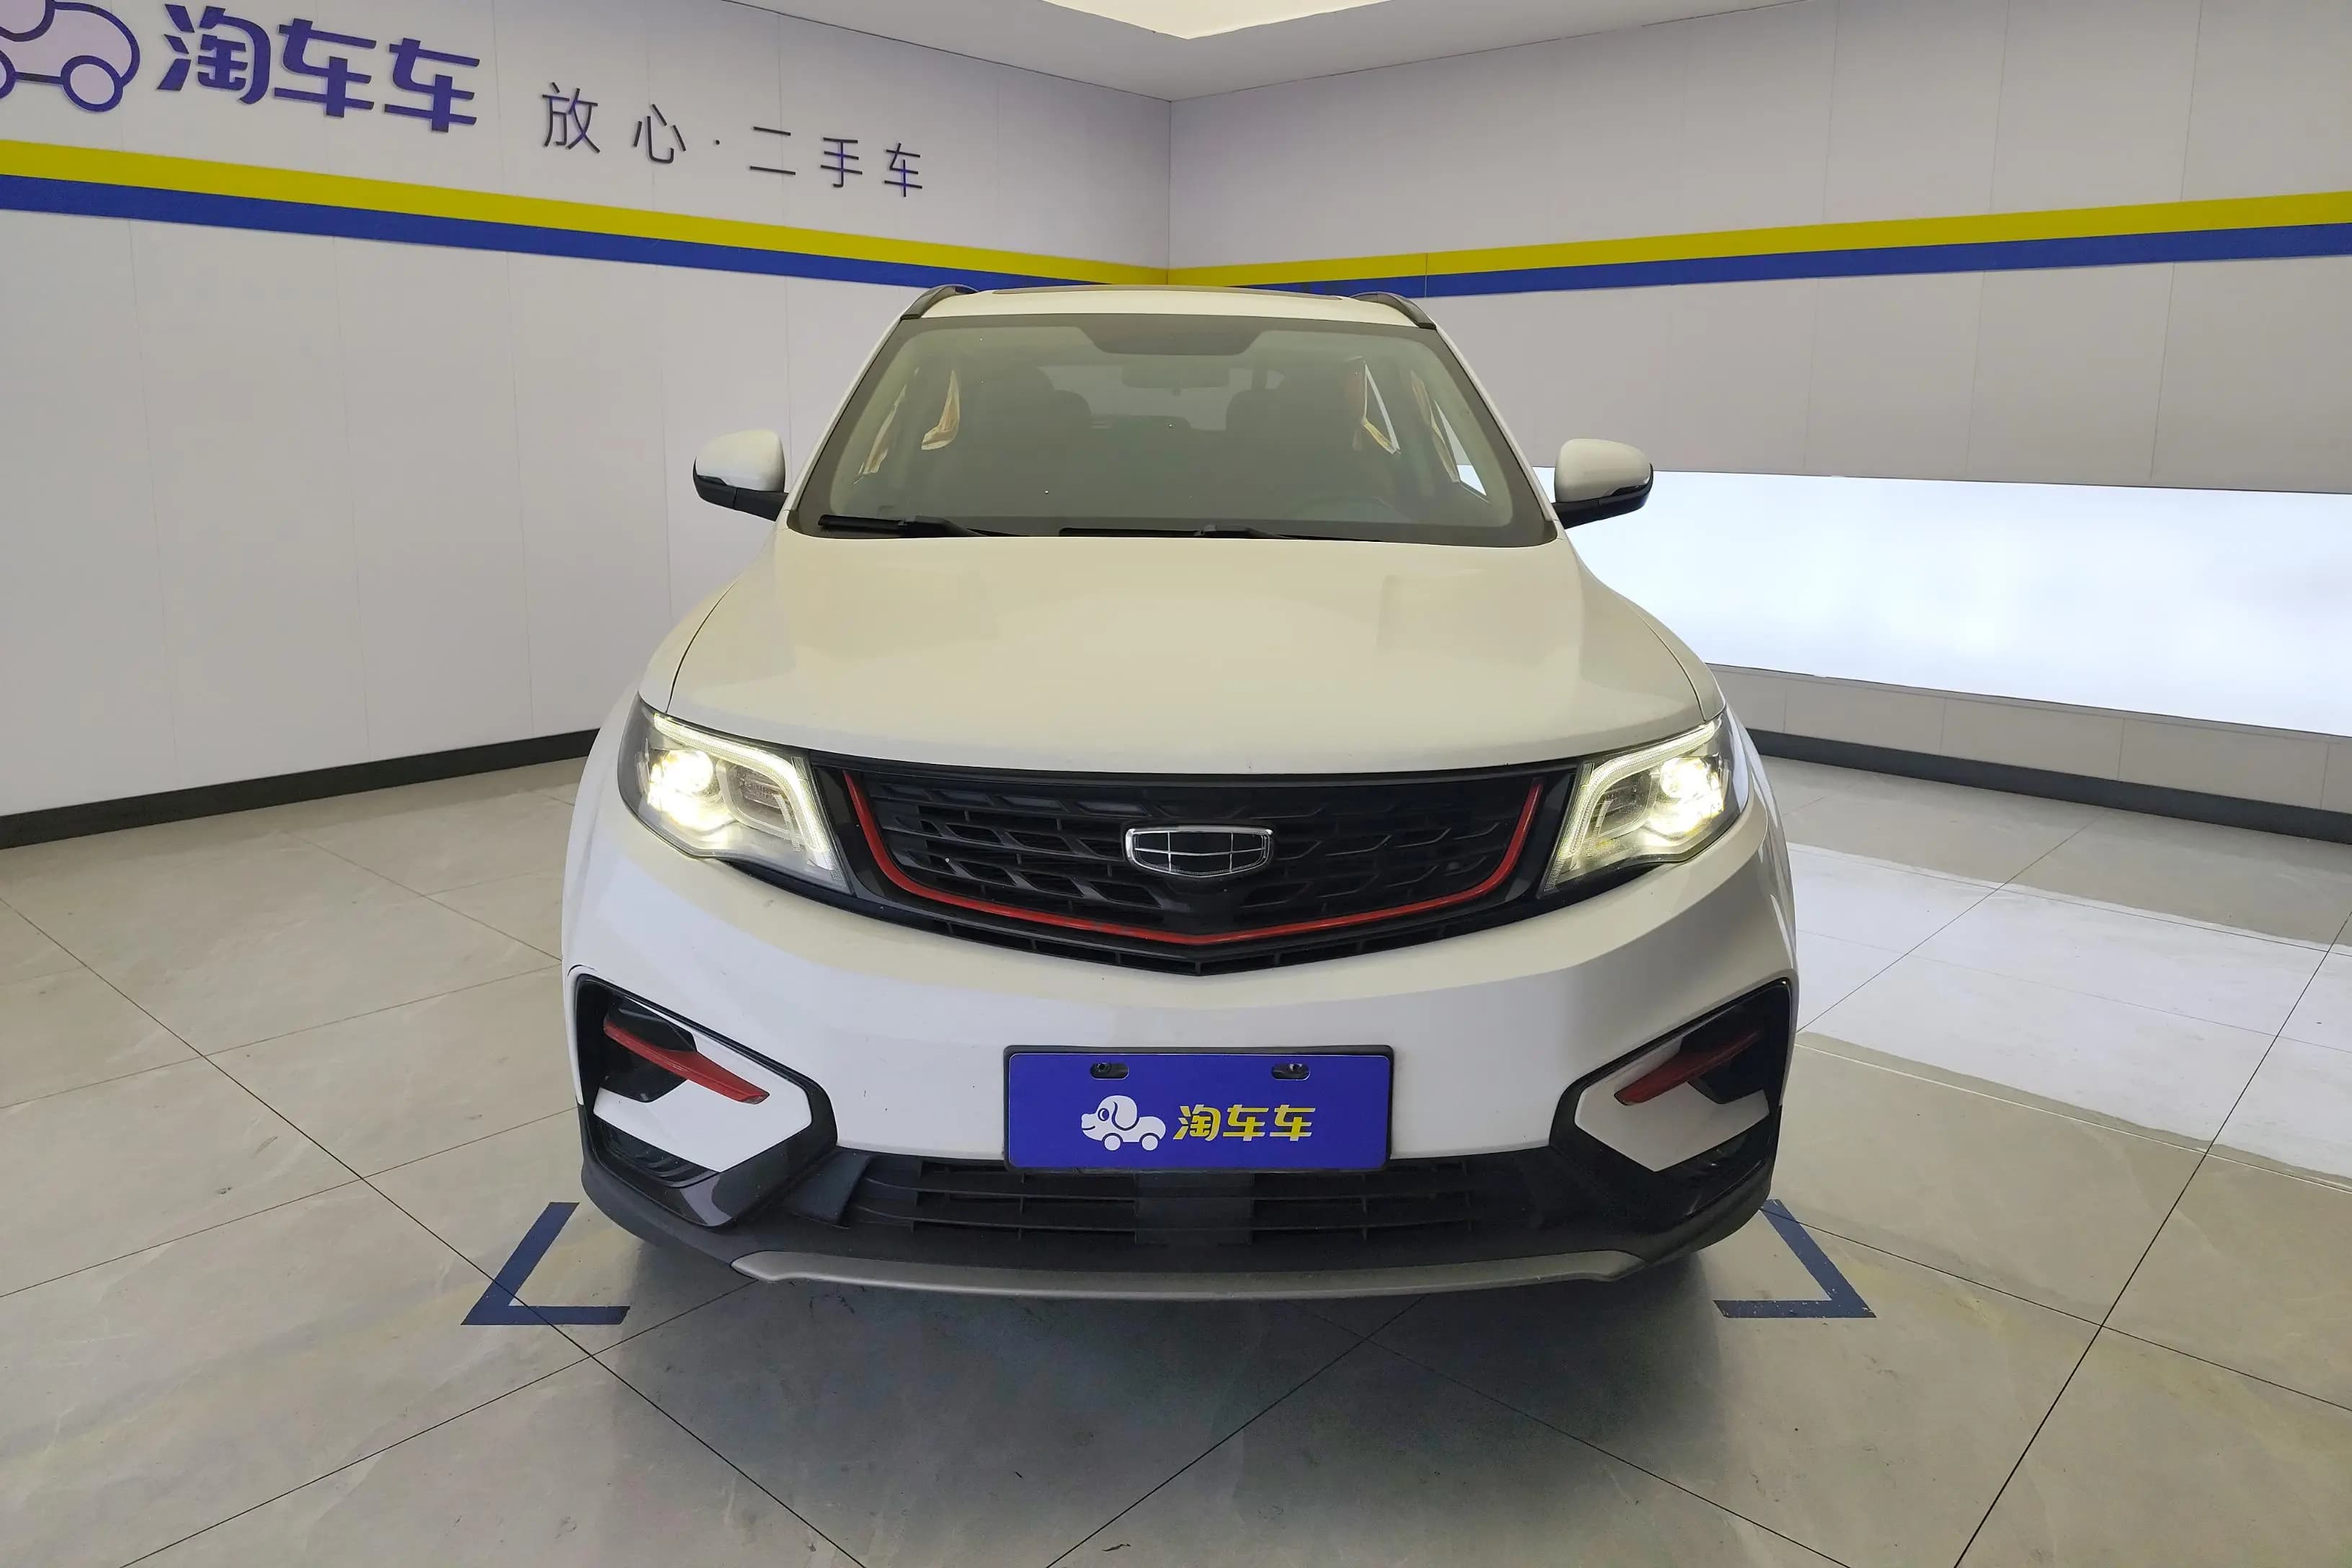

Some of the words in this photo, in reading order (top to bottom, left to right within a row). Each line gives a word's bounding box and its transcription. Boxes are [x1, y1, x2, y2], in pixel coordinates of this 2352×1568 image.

[157, 4, 481, 133] 淘车车
[1172, 1104, 1317, 1141] 淘车车
